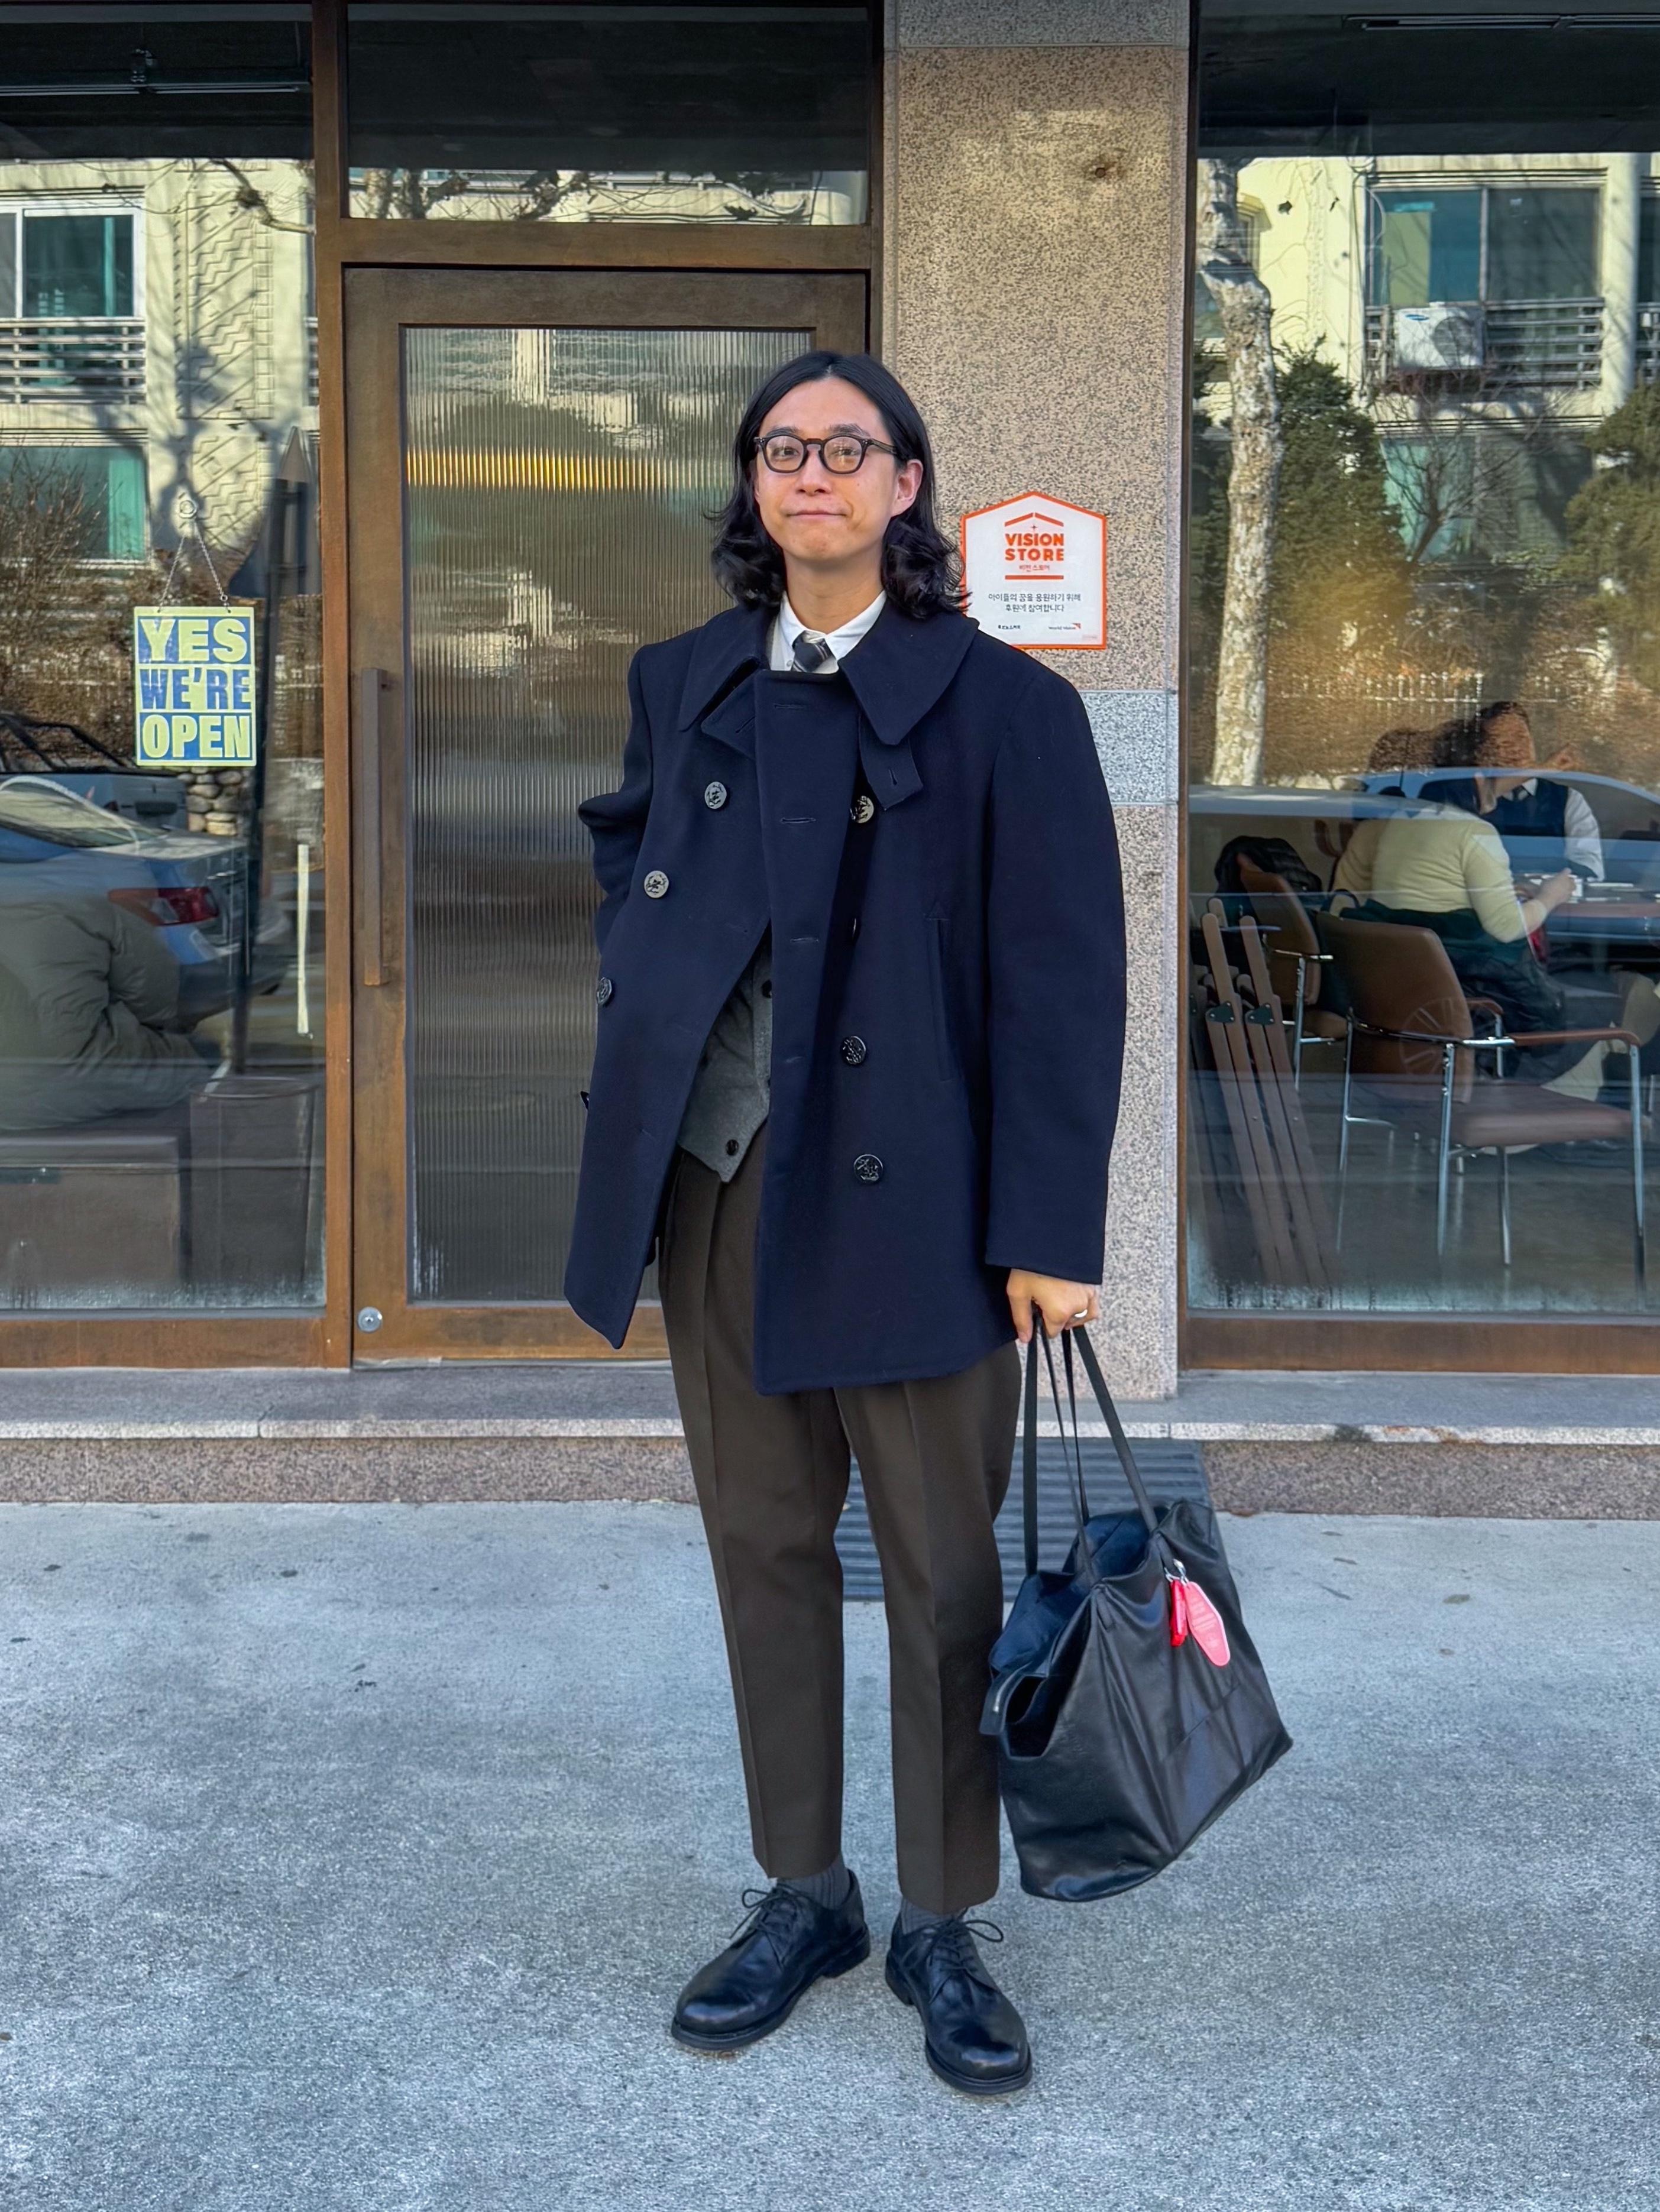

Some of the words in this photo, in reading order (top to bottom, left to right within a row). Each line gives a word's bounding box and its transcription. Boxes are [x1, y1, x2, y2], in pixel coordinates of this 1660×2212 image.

[1005, 533, 1064, 546] VISION
[1005, 549, 1064, 561] STORE
[988, 593, 1017, 601] 아이들의
[1028, 604, 1064, 612] 참여합니다
[140, 618, 247, 662] YES
[140, 667, 251, 710] WE'RE
[142, 714, 250, 759] OPEN
